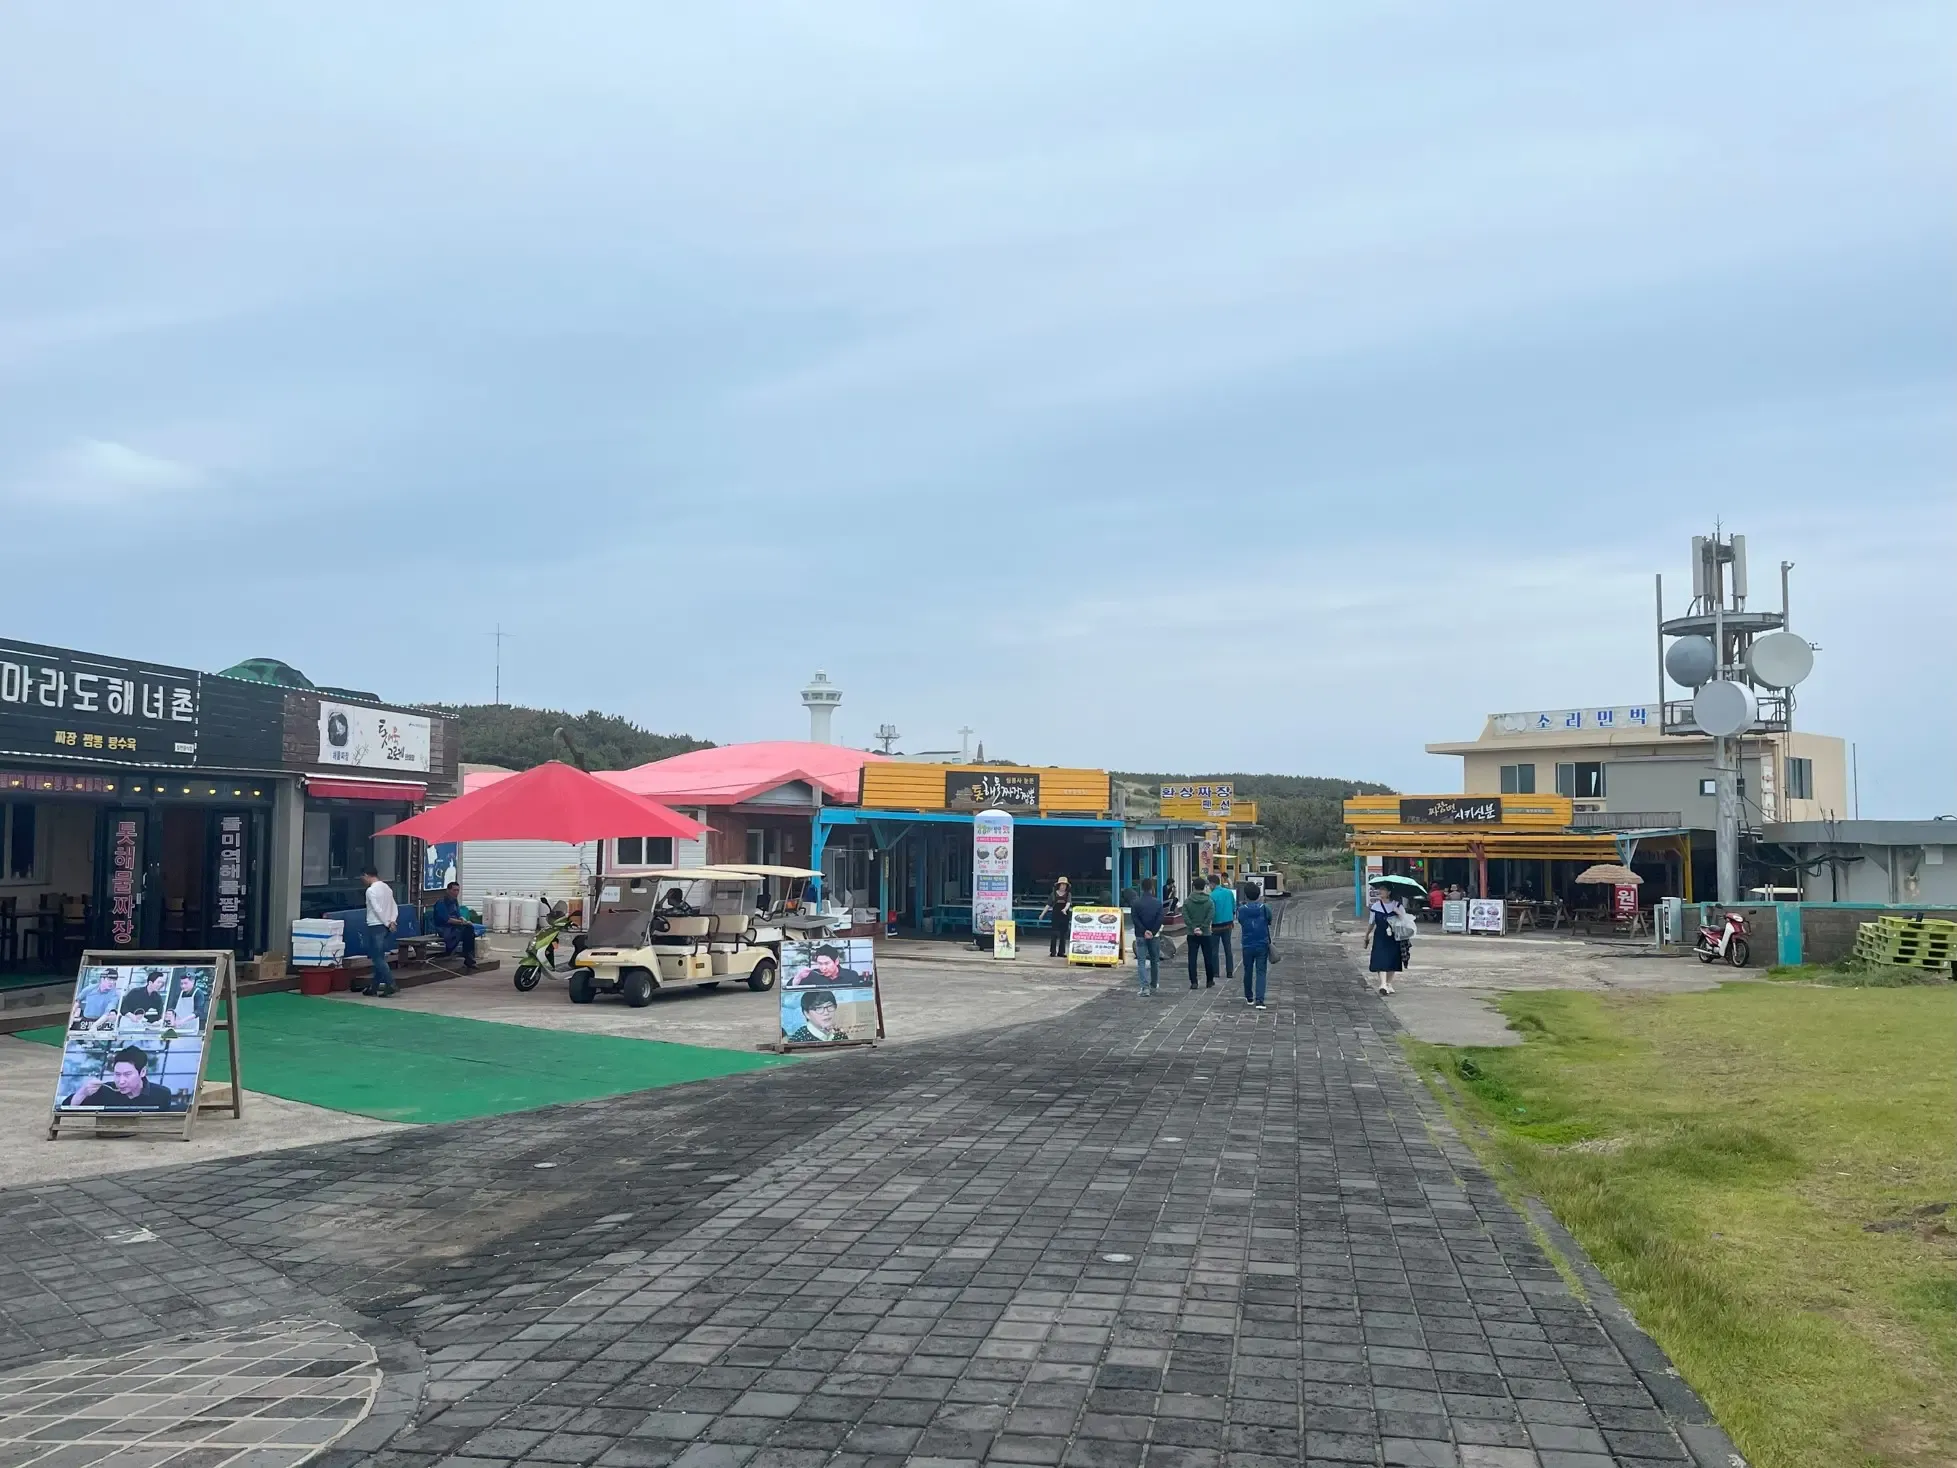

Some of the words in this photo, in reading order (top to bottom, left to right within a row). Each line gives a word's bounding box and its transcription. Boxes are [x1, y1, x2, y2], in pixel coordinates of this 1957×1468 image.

[1, 662, 194, 722] 마라도해녀촌
[1535, 707, 1648, 730] 소리민박
[54, 730, 77, 746] 짜장
[82, 733, 104, 749] 짬뽕
[108, 737, 137, 751] 탕수육
[1161, 786, 1233, 799] 환상짜장
[111, 821, 138, 945] 톳해물짜장
